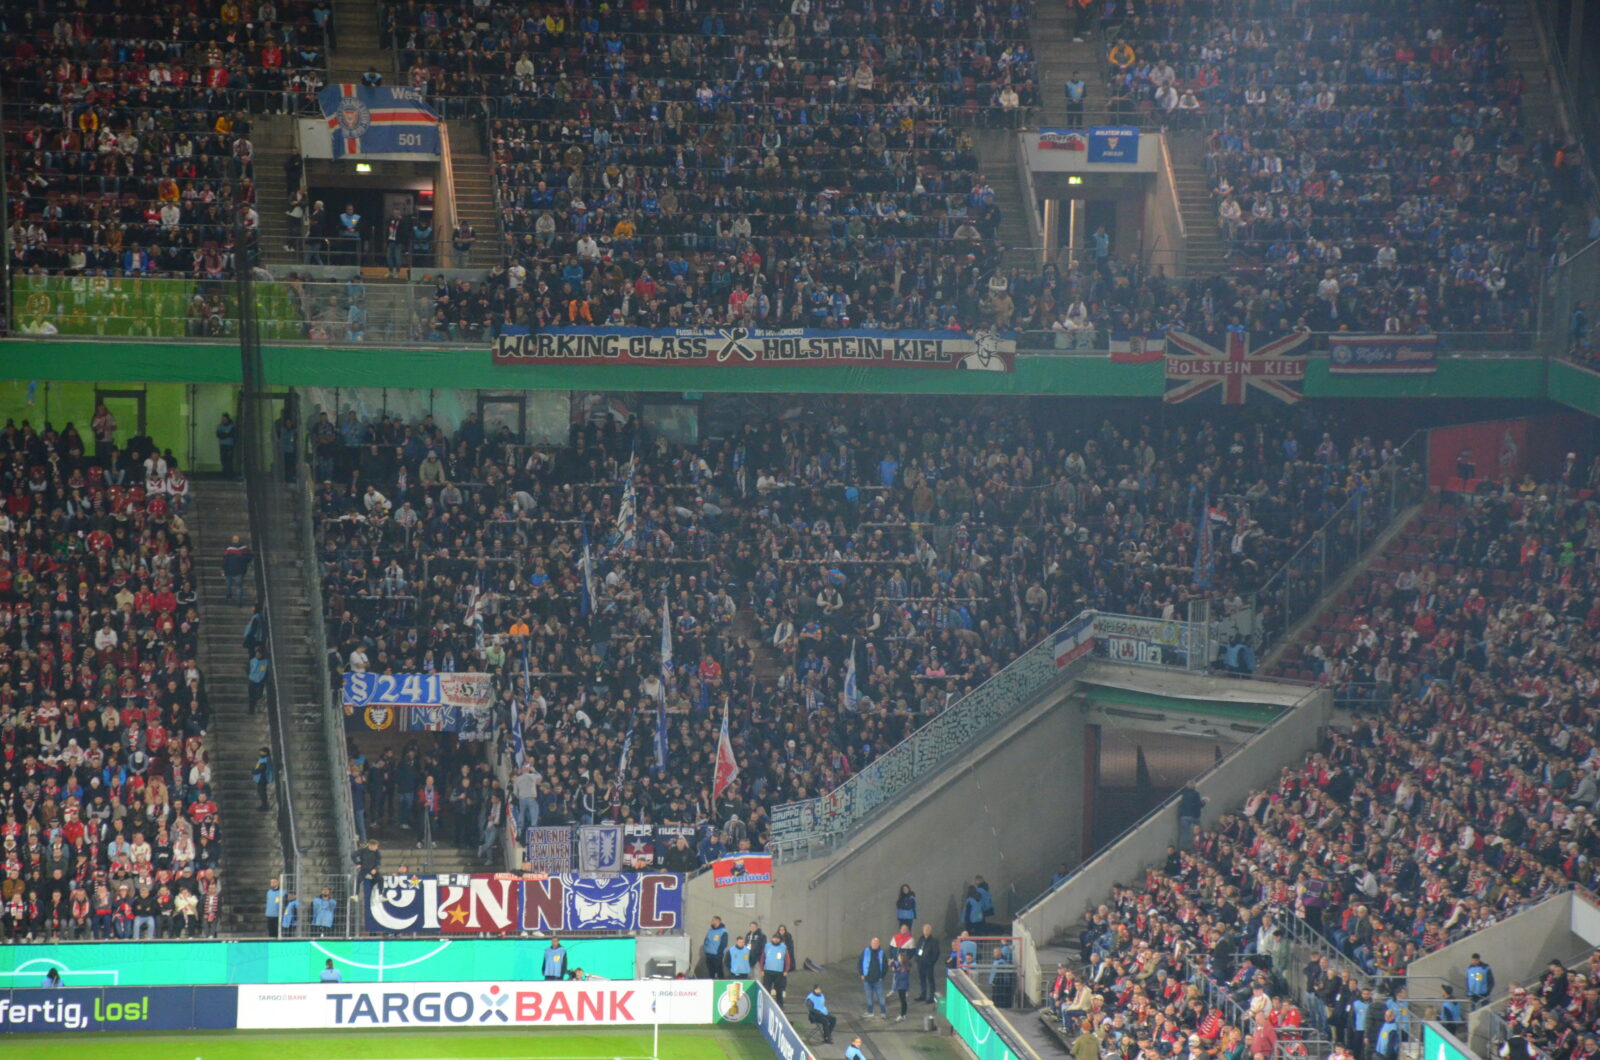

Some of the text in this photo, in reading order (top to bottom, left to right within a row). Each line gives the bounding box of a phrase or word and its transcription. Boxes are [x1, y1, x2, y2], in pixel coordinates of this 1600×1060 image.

[399, 133, 422, 146] 501
[497, 334, 709, 358] WORKING CLASS
[761, 336, 952, 362] HOLSTEIN KIEL
[1168, 358, 1304, 376] HOLSTEIN KIEL
[378, 674, 438, 703] 241
[530, 830, 569, 842] AM ENDE
[94, 996, 148, 1021] los!
